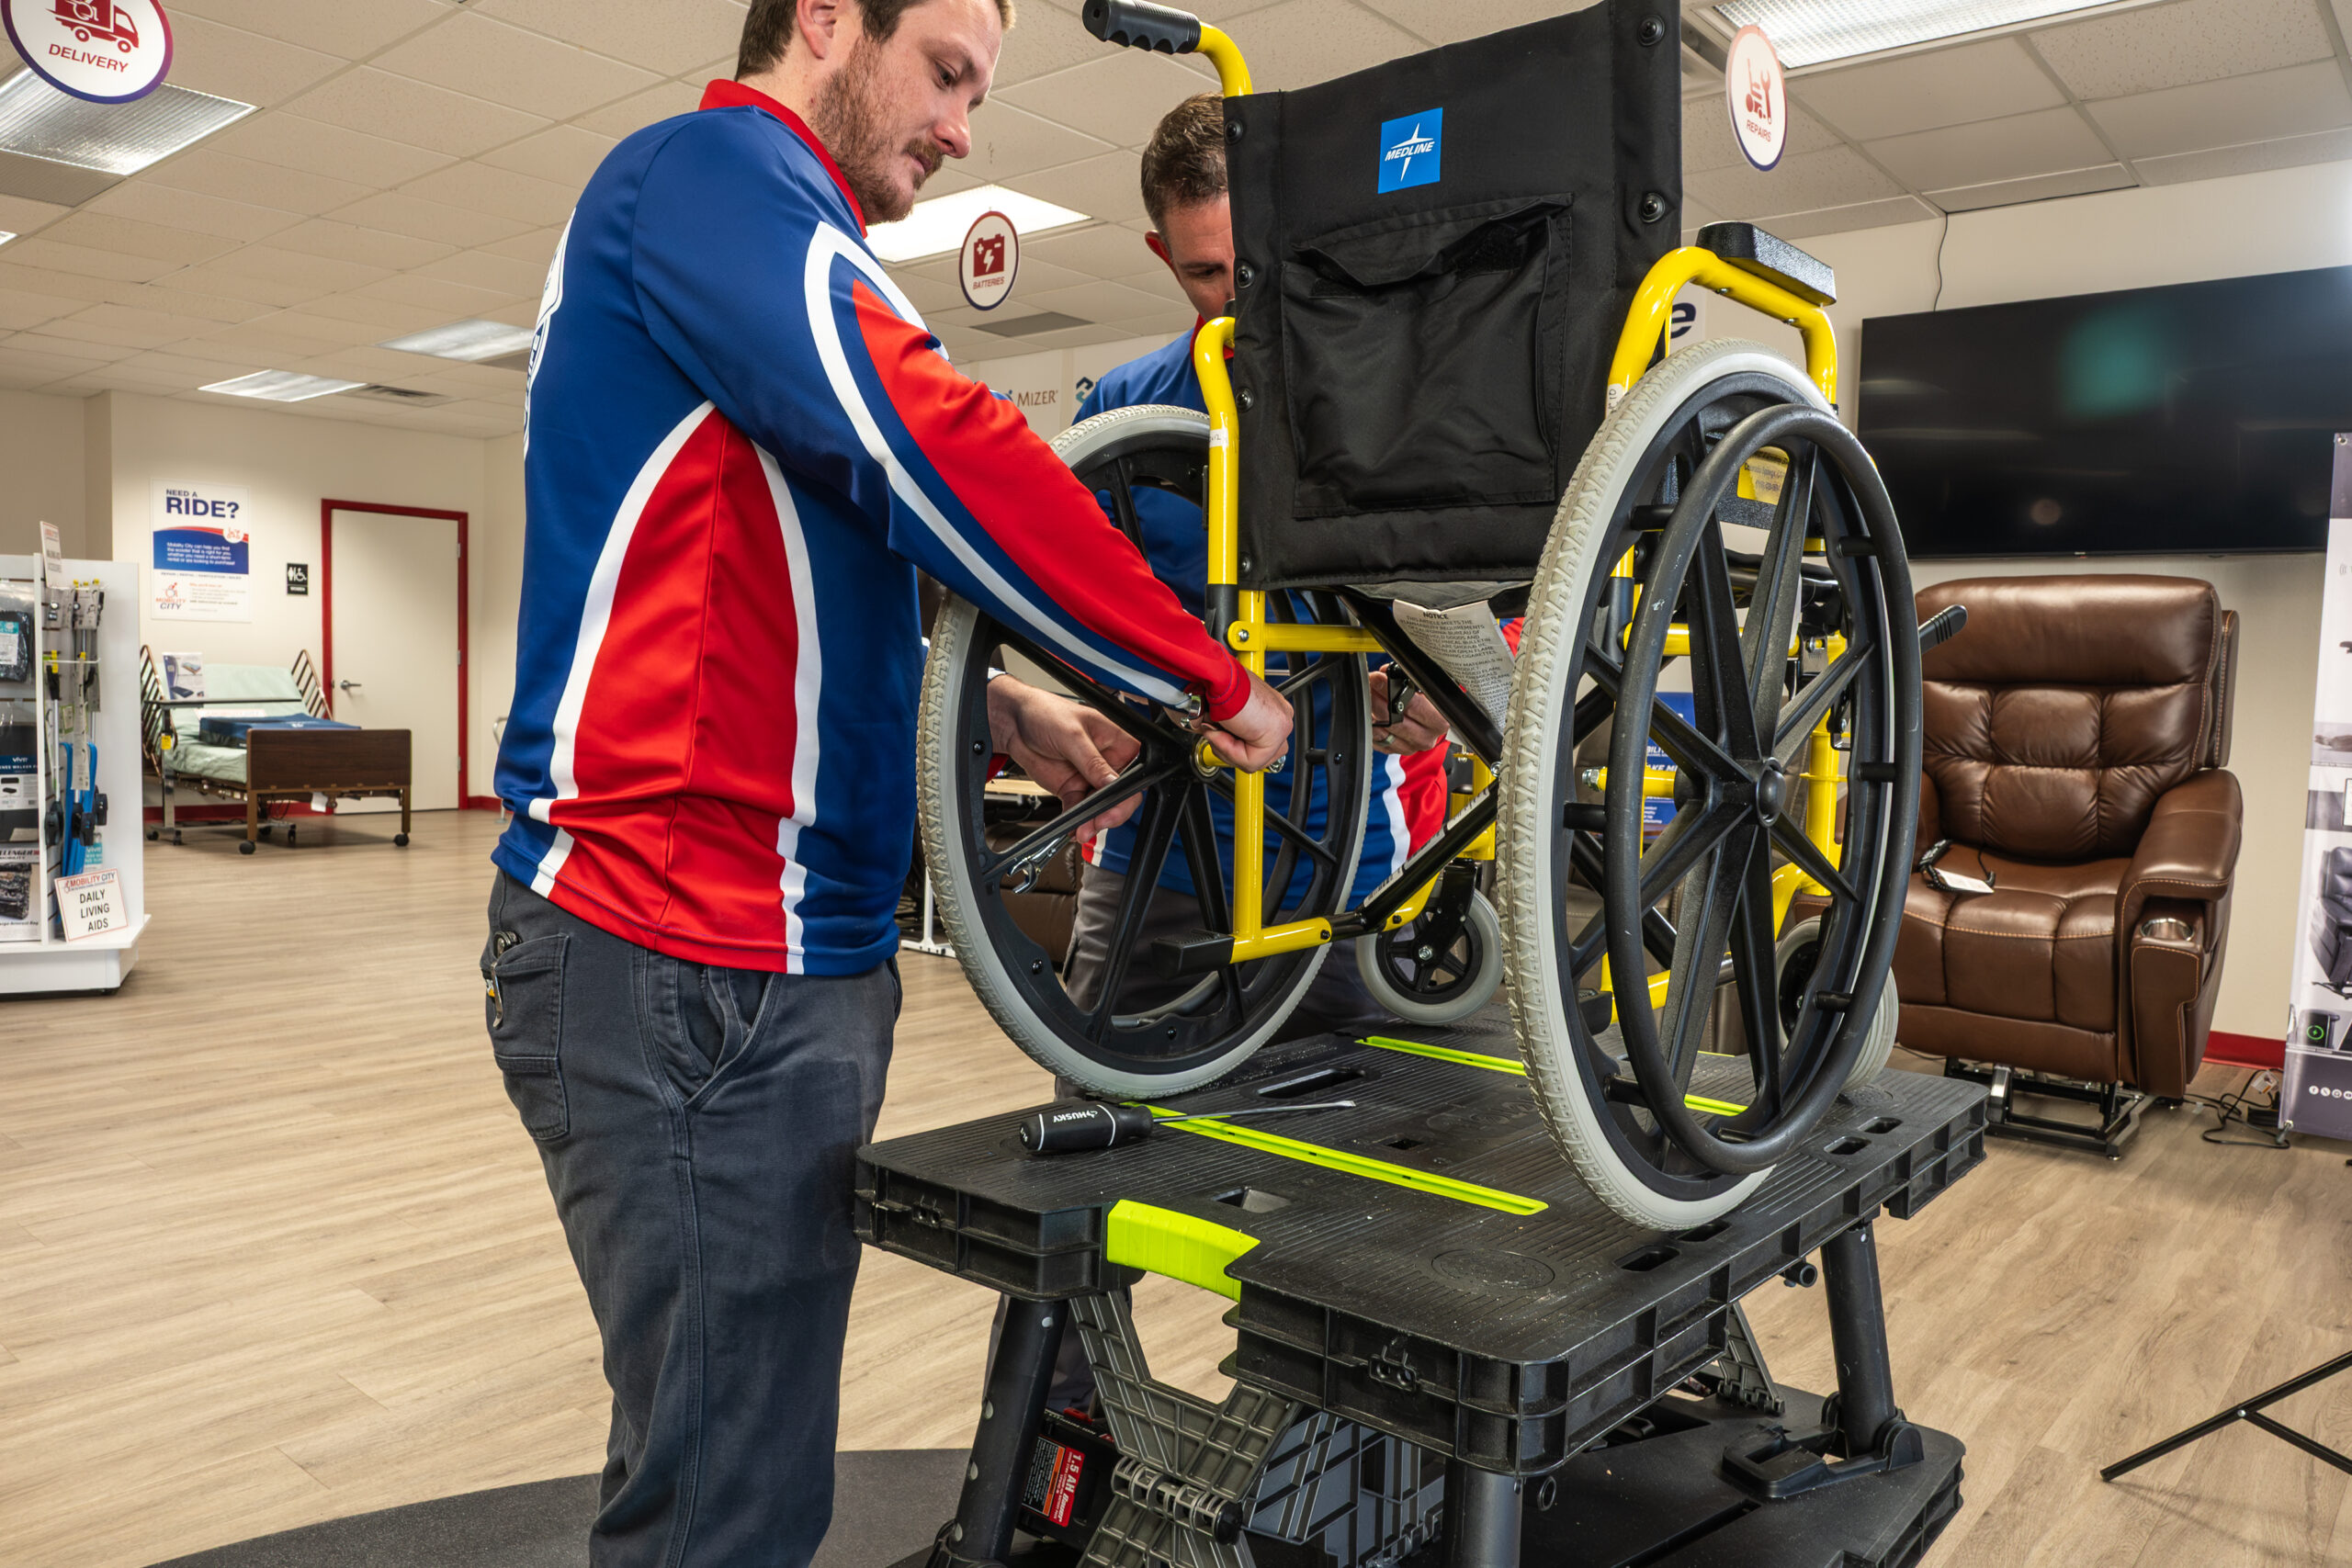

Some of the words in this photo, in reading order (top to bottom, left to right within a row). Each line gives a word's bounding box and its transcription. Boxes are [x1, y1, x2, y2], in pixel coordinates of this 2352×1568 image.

[48, 43, 129, 73] DELIVERY
[1746, 118, 1771, 142] REPAIRS
[1385, 141, 1435, 162] MEDLINE
[972, 276, 1005, 290] BATTERIES
[1017, 390, 1057, 407] MIZER
[166, 489, 189, 497] NEED
[166, 497, 240, 518] RIDE?
[160, 603, 182, 611] CITY
[1423, 612, 1449, 620] NOTICE
[70, 874, 100, 888] MOBILITY
[101, 872, 116, 882] CITY
[79, 888, 106, 904] DAILY
[81, 903, 110, 919] LIVING
[88, 919, 108, 931] AIDS
[1053, 1111, 1088, 1123] HUSKY
[1069, 1453, 1082, 1473] 1.5
[1065, 1473, 1077, 1494] AH
[1057, 1493, 1069, 1523] Bauer
